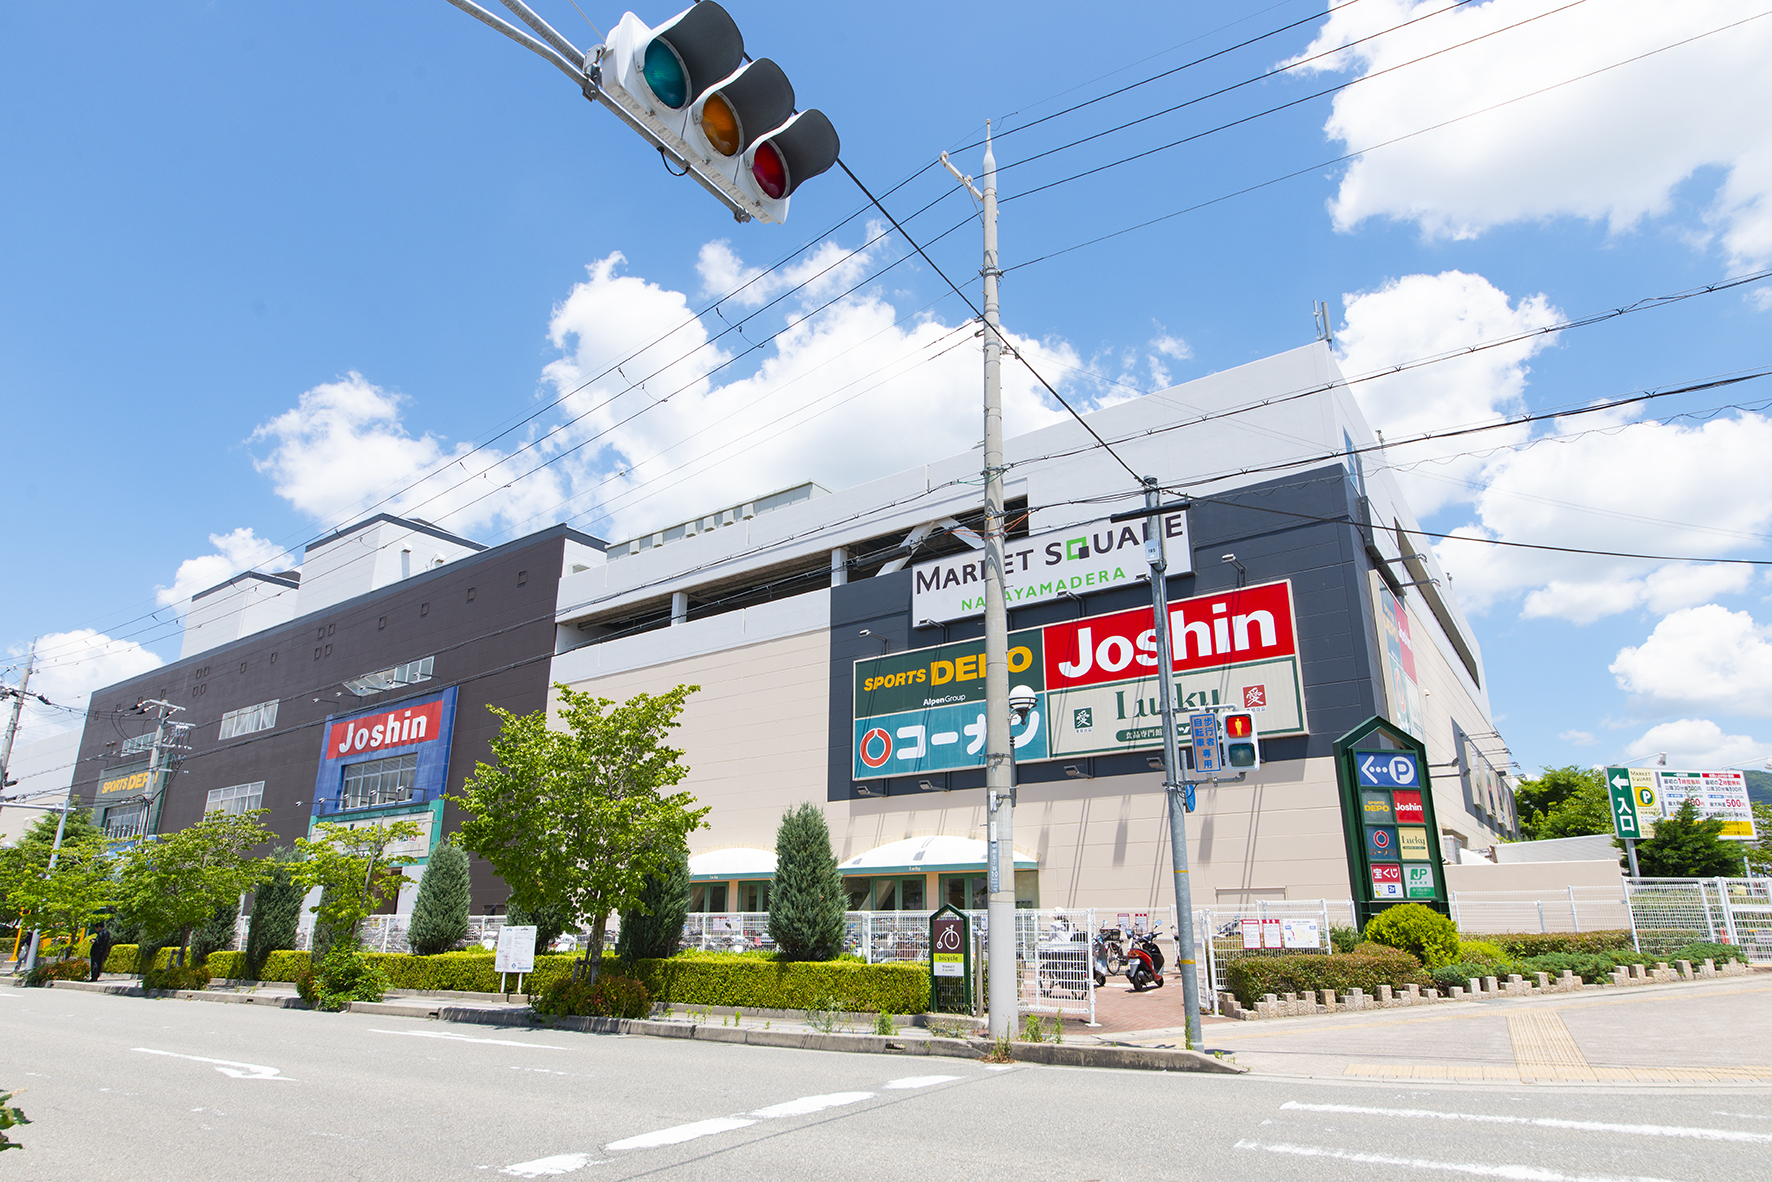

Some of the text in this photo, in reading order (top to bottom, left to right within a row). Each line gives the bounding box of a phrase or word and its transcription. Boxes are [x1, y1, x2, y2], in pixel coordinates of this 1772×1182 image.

[961, 567, 1126, 611] NAAYAMADERA
[1058, 602, 1277, 678] Joshin
[864, 668, 926, 692] SPORTS
[1115, 683, 1219, 720] Luky
[339, 710, 427, 753] Joshin
[1394, 760, 1410, 780] P
[102, 777, 127, 794] SPORTS
[1364, 804, 1390, 812] DEPO
[1395, 803, 1422, 811] Joshin
[1642, 791, 1652, 803] P
[1617, 797, 1635, 831] 入口
[1373, 868, 1398, 879] 宝くじ
